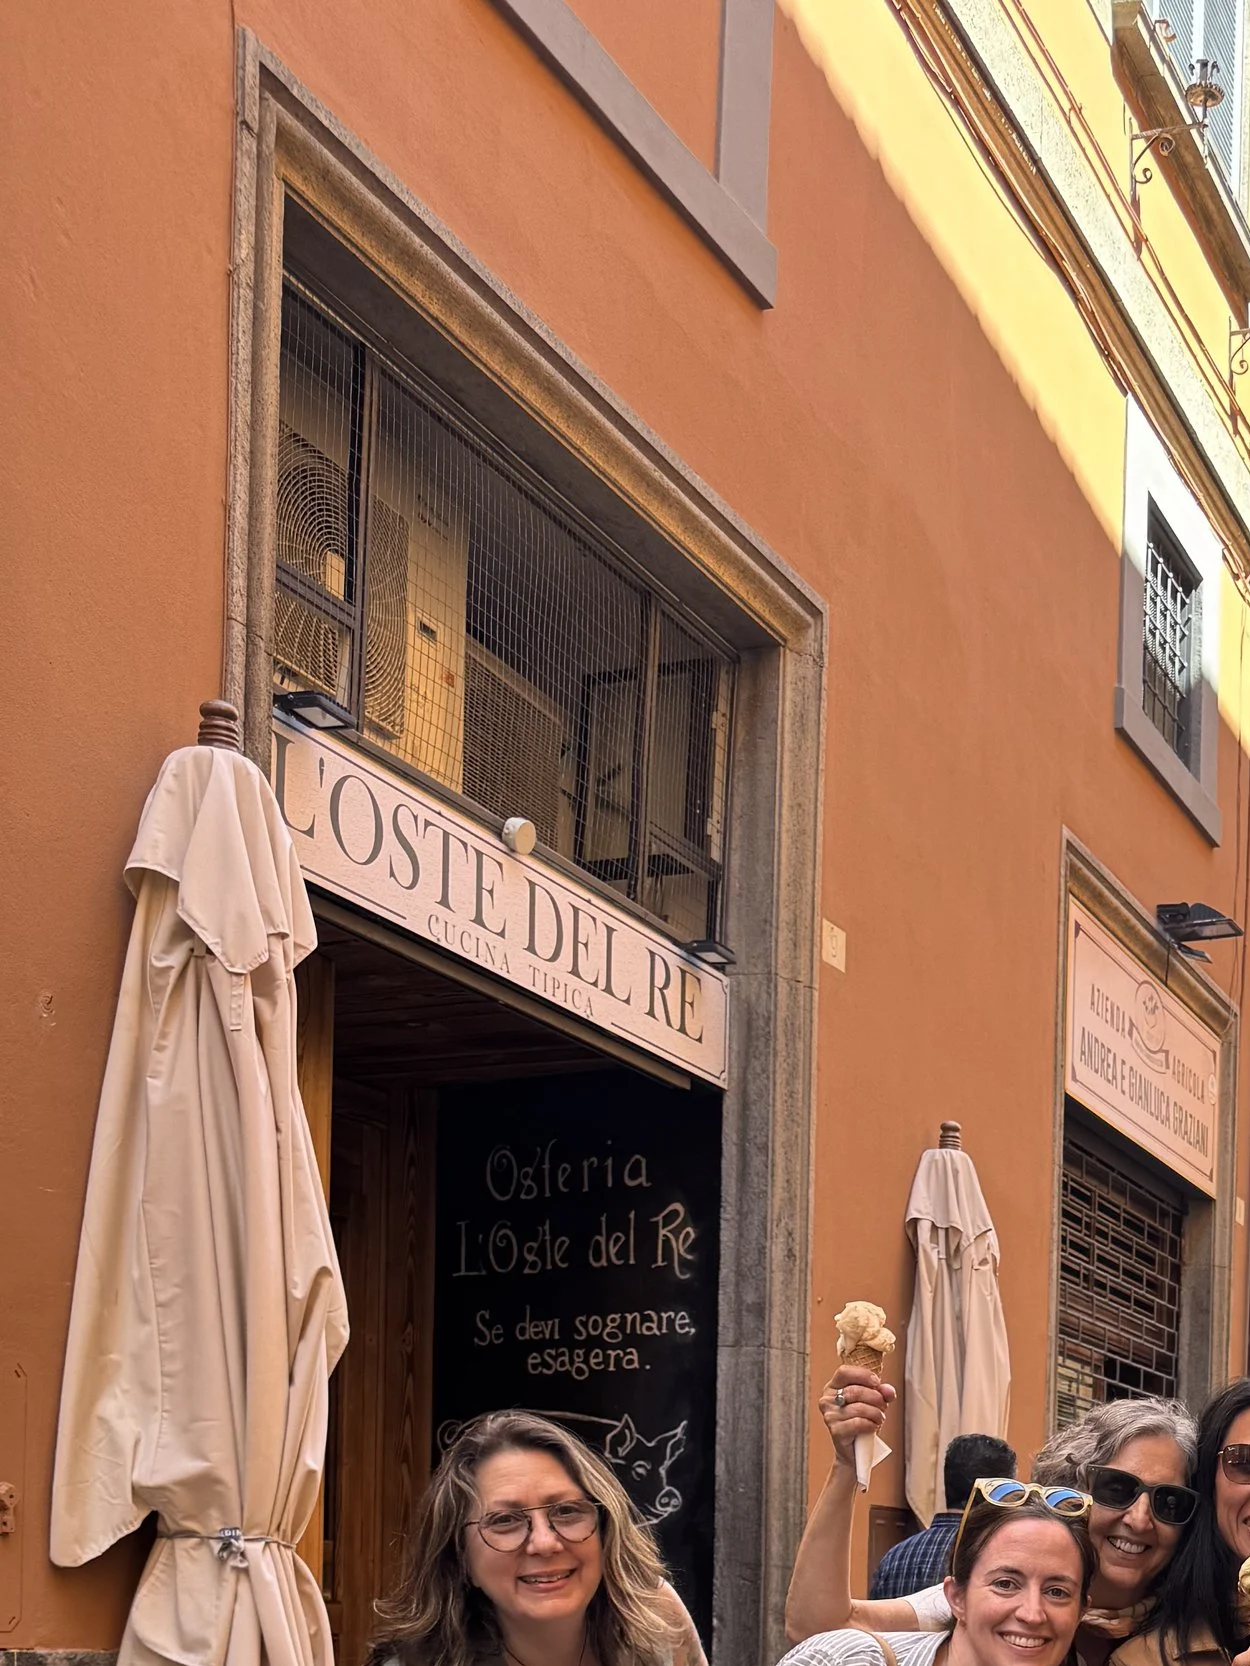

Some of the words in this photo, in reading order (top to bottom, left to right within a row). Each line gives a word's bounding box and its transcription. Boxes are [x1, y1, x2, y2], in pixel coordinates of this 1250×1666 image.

[272, 730, 507, 940] L'OSTE
[523, 876, 632, 1006] DEL
[645, 946, 704, 1045] RE
[427, 913, 511, 975] CUCINA
[528, 964, 594, 1018] TIPICA
[1090, 983, 1127, 1040] AZIENDA
[1171, 1055, 1206, 1105] AGRICOLA
[1079, 1026, 1119, 1091] ANDREA
[1119, 1058, 1127, 1096] E
[1128, 1065, 1171, 1131] GIANLUCA
[1172, 1101, 1209, 1158] GRAZIANI
[486, 1138, 653, 1201] Osteria
[453, 1218, 570, 1275] L'Oste
[588, 1209, 636, 1267] del
[650, 1202, 697, 1280] Re
[474, 1308, 505, 1346] Se
[515, 1304, 561, 1341] devi
[574, 1309, 697, 1344] sognare,
[527, 1346, 651, 1381] esagera.
